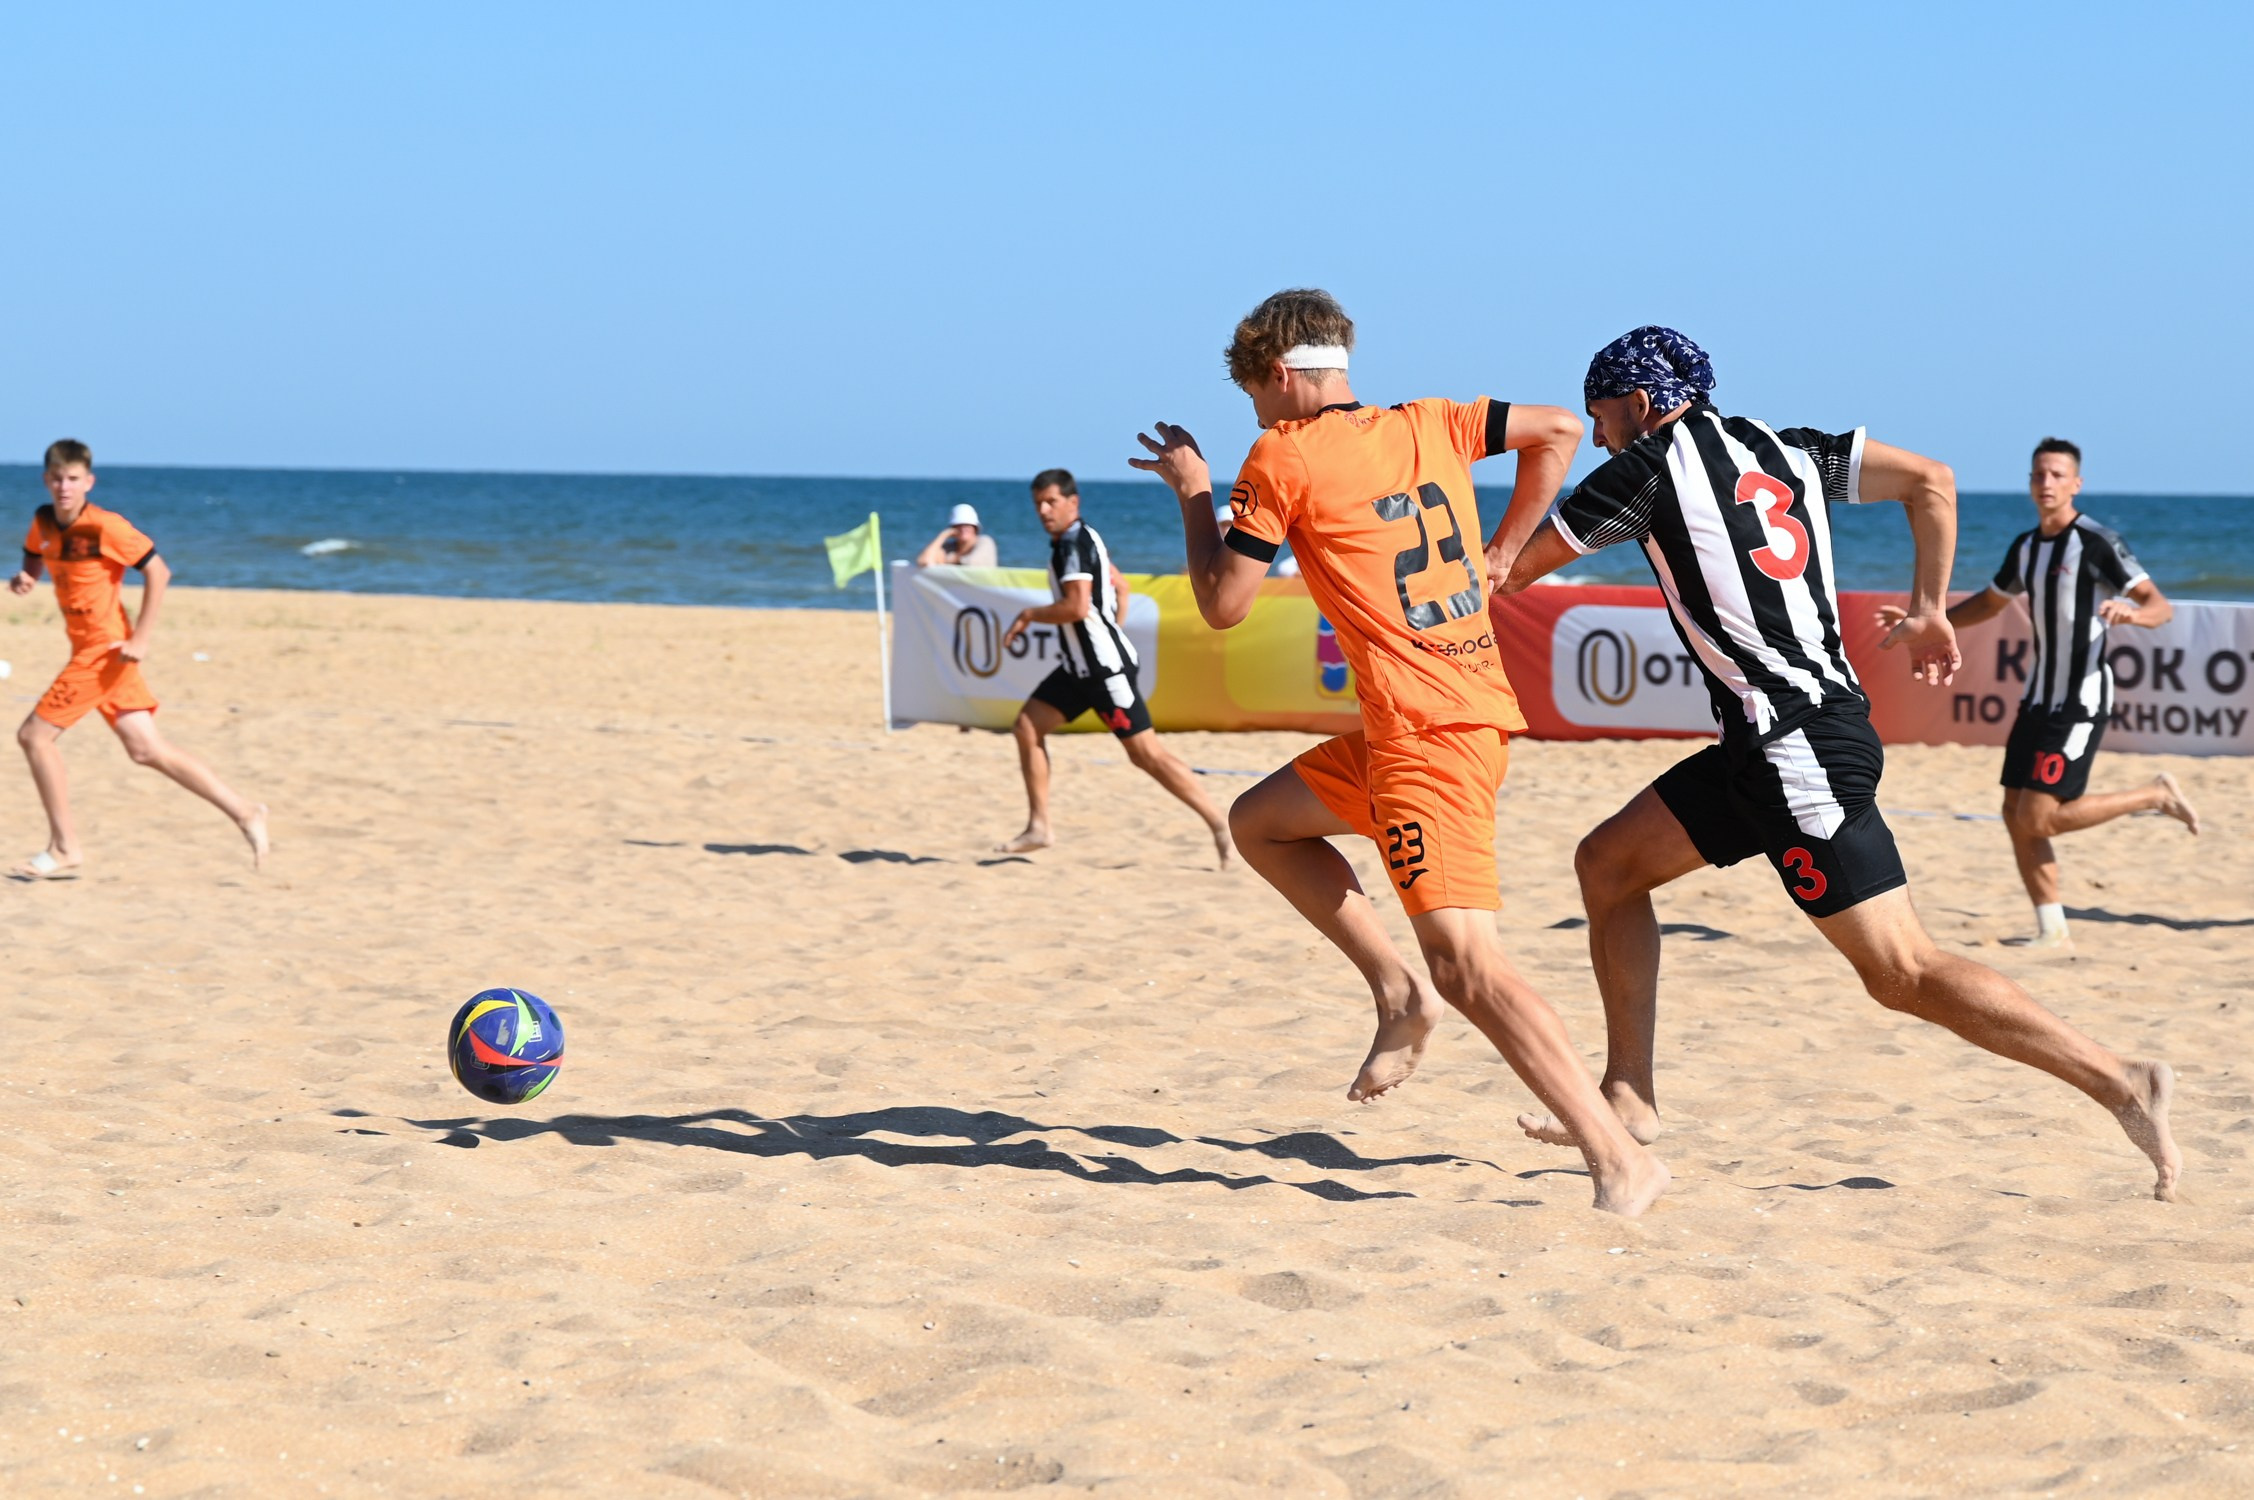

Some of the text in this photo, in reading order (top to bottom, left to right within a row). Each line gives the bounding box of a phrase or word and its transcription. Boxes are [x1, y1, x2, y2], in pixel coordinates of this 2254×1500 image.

[1736, 470, 1809, 580] 3
[1371, 481, 1482, 632] 23
[1996, 638, 2184, 692] КОК
[1953, 694, 2006, 725] ПО
[2031, 751, 2065, 785] 10
[1386, 821, 1425, 870] 23
[1782, 846, 1828, 901] 3
